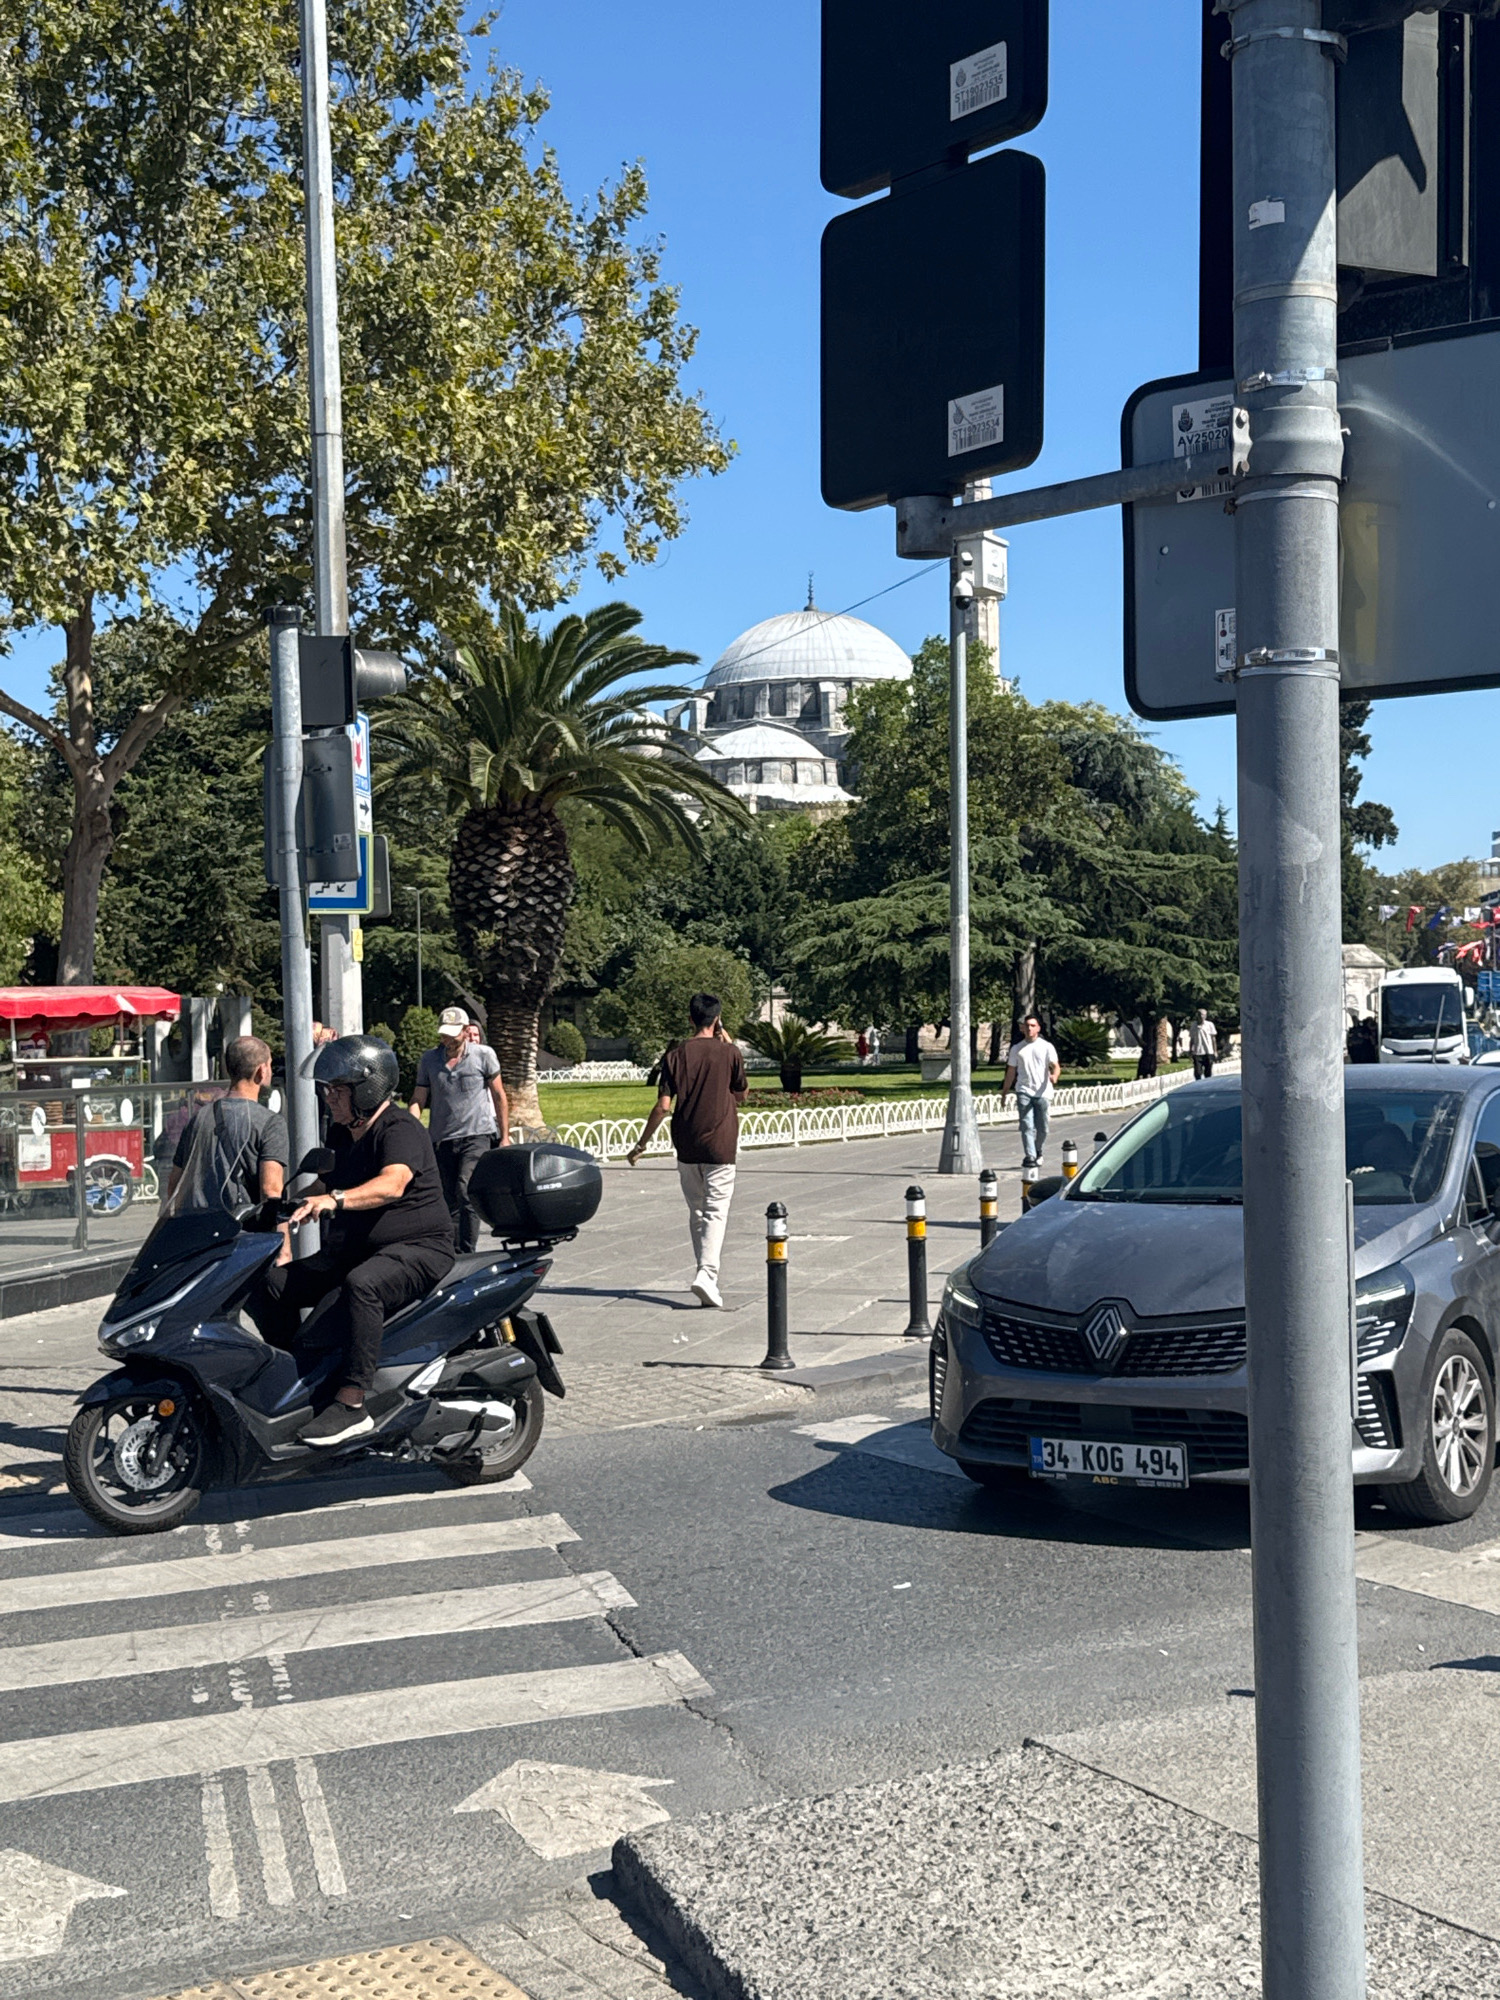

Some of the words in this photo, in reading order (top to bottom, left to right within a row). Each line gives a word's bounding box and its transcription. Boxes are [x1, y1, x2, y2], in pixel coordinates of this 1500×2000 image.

[1043, 1442, 1070, 1469] 34
[1081, 1444, 1124, 1473] KOG
[1135, 1447, 1179, 1476] 494
[1092, 1475, 1119, 1485] ABC
